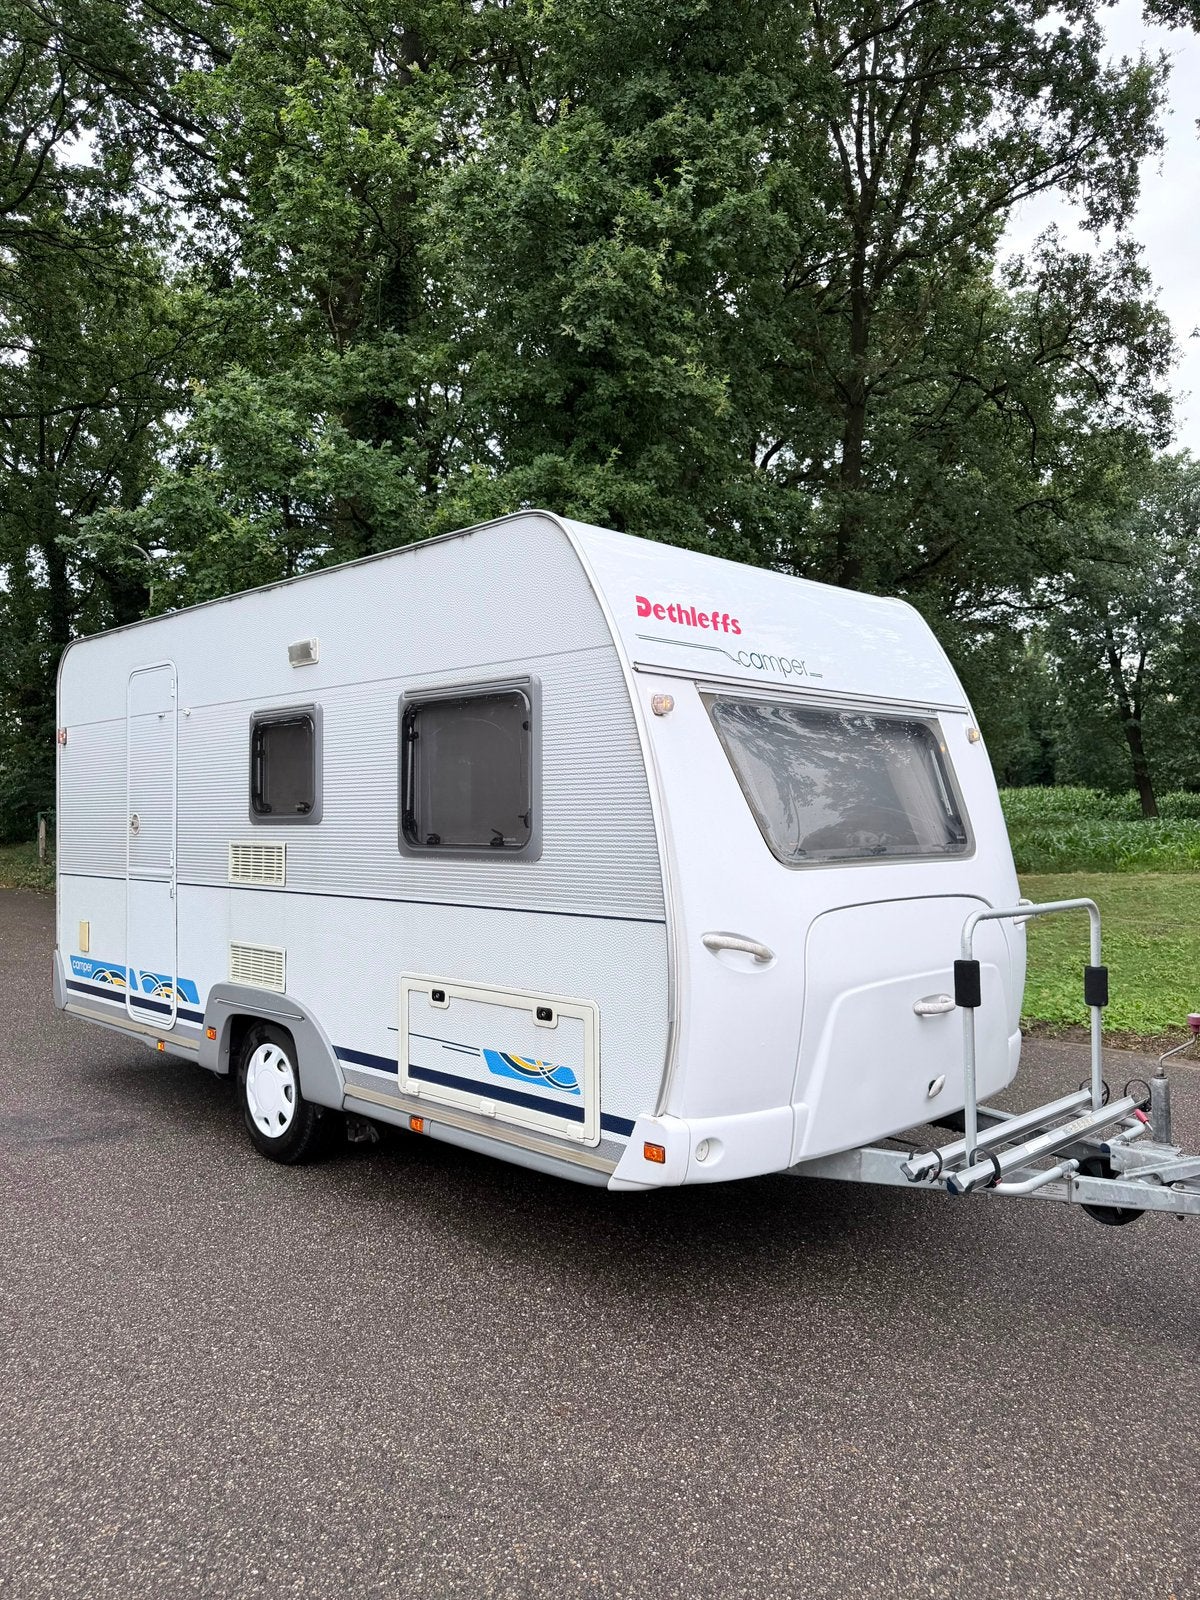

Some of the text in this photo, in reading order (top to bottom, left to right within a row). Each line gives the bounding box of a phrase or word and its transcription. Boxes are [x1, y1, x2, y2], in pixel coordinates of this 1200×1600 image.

[635, 595, 742, 635] Dethleffs
[737, 650, 808, 678] camper
[72, 960, 93, 973] camper
